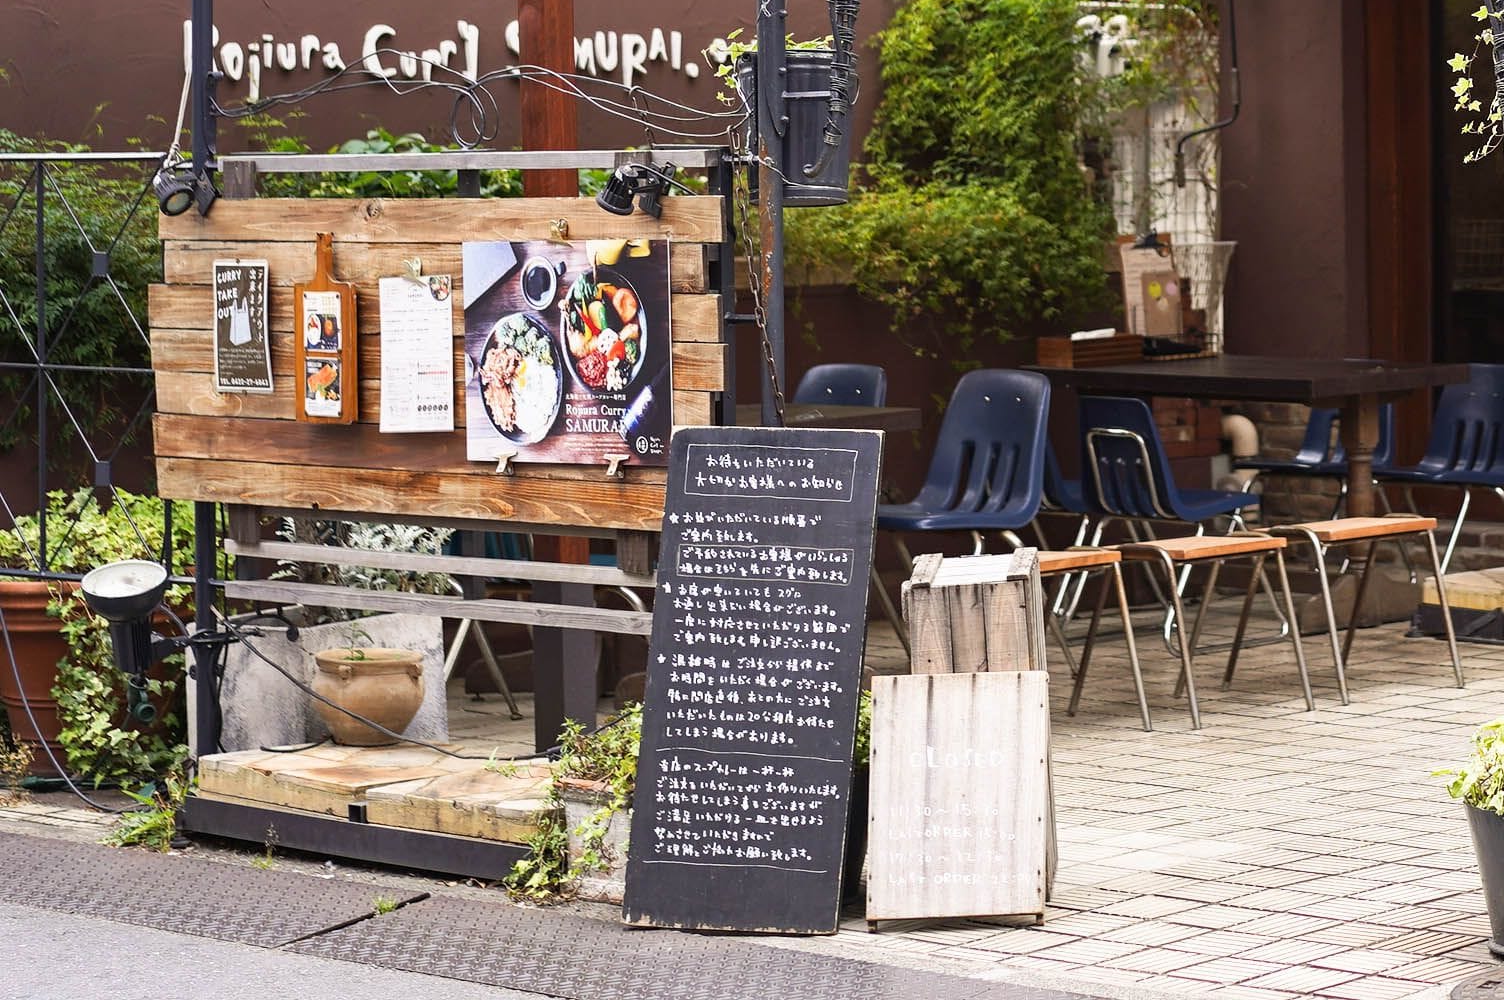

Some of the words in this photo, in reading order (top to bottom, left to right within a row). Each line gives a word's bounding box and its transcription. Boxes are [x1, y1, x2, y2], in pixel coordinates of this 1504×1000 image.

[362, 20, 480, 83] Curry
[505, 20, 699, 88] MURAI.
[217, 269, 242, 283] CURRY
[217, 287, 238, 301] TAKE
[217, 306, 234, 319] OUT
[565, 404, 598, 418] Rojiura
